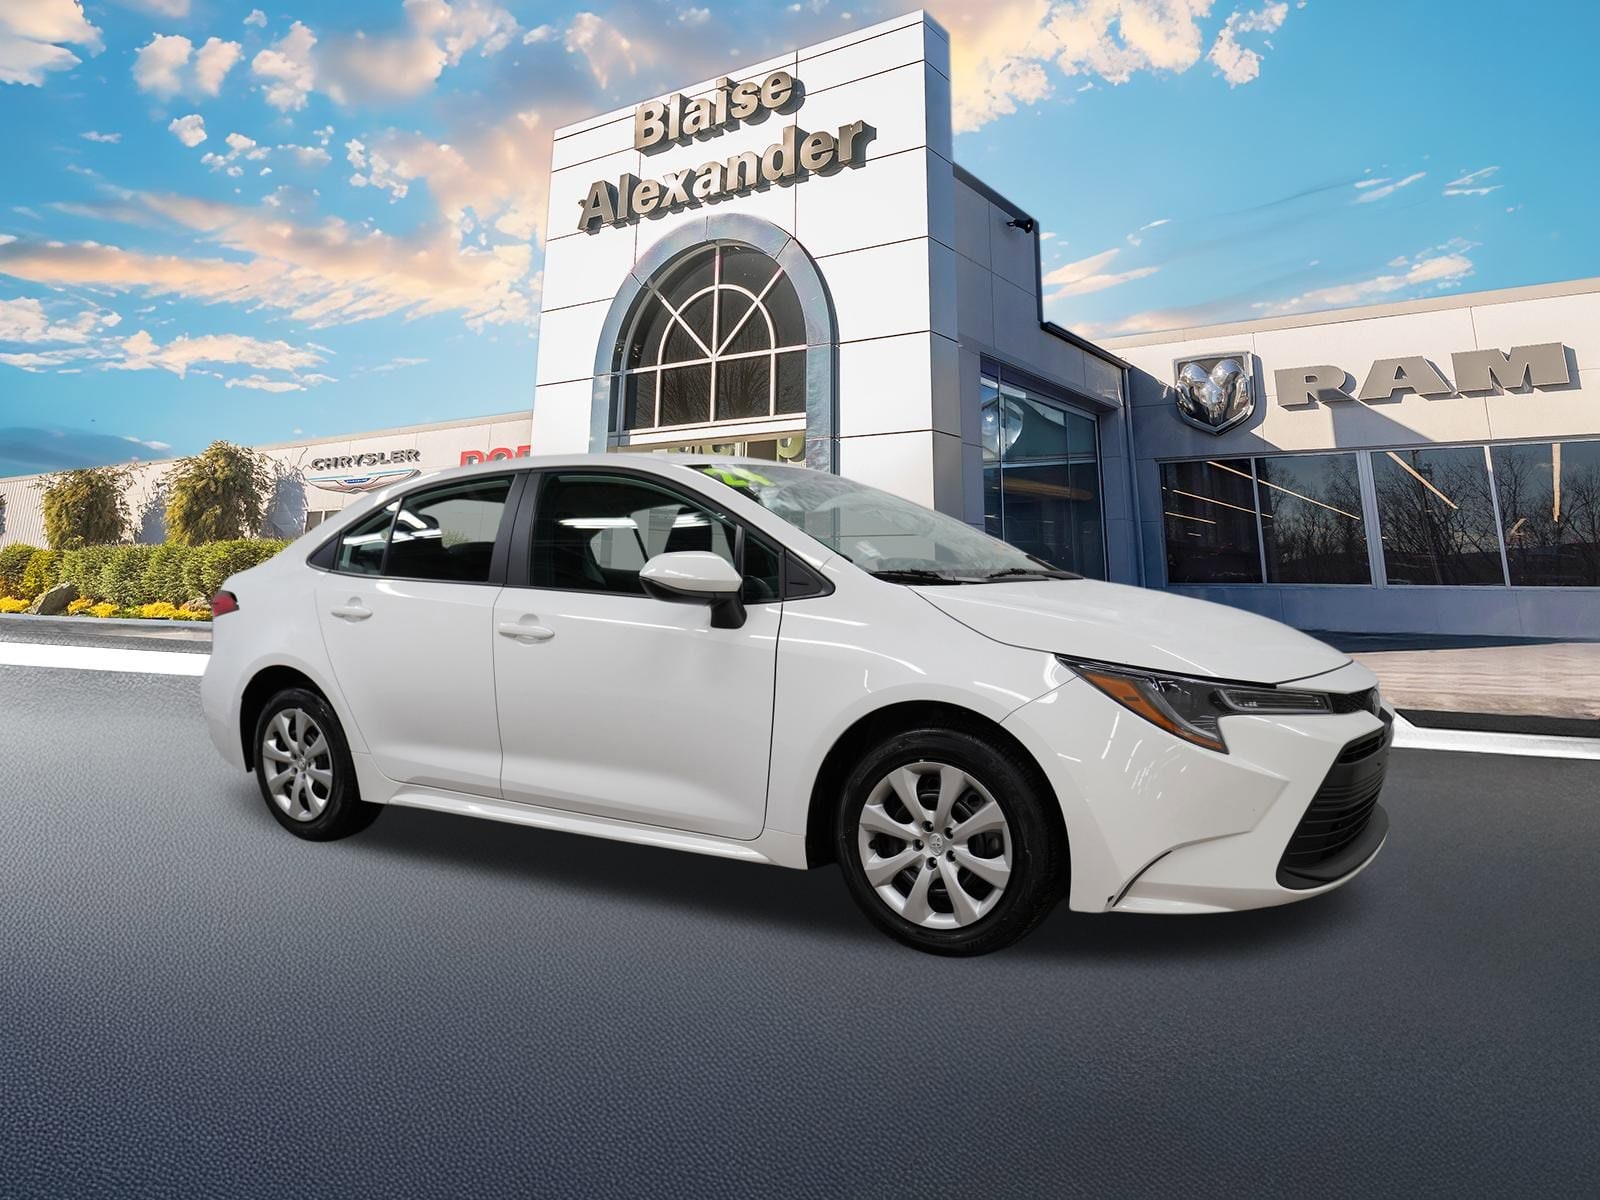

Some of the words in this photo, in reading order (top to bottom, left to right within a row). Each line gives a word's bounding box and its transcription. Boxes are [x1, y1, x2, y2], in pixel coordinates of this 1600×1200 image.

[635, 71, 803, 156] Blaise
[577, 120, 875, 233] Alexander
[1274, 342, 1571, 409] RAM
[312, 449, 420, 471] CHRYSLER
